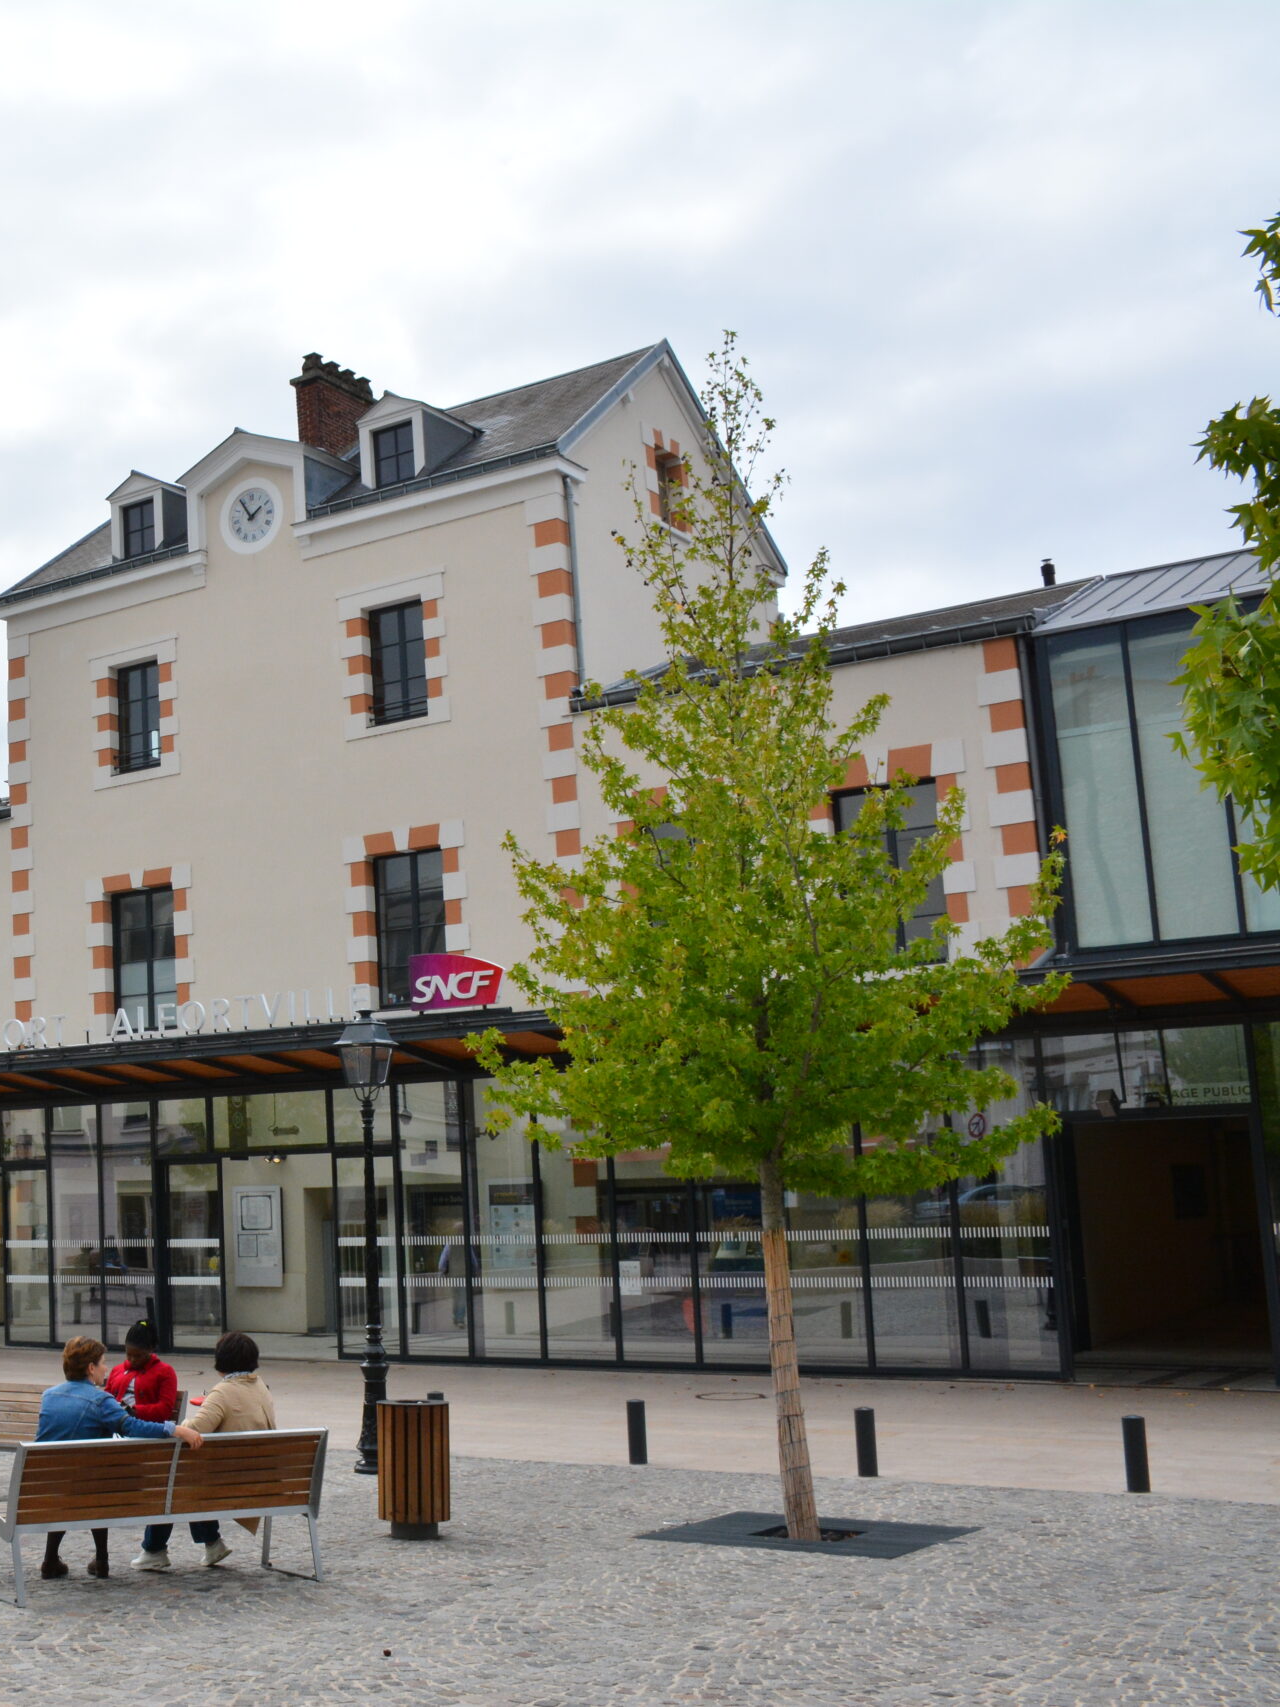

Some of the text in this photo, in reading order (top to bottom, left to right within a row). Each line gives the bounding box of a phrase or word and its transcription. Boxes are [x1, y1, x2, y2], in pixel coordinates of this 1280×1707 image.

[411, 969, 495, 1004] SNCF
[110, 984, 369, 1039] ALFORTVILLE
[1170, 1084, 1252, 1099] AGE PUBLIC
